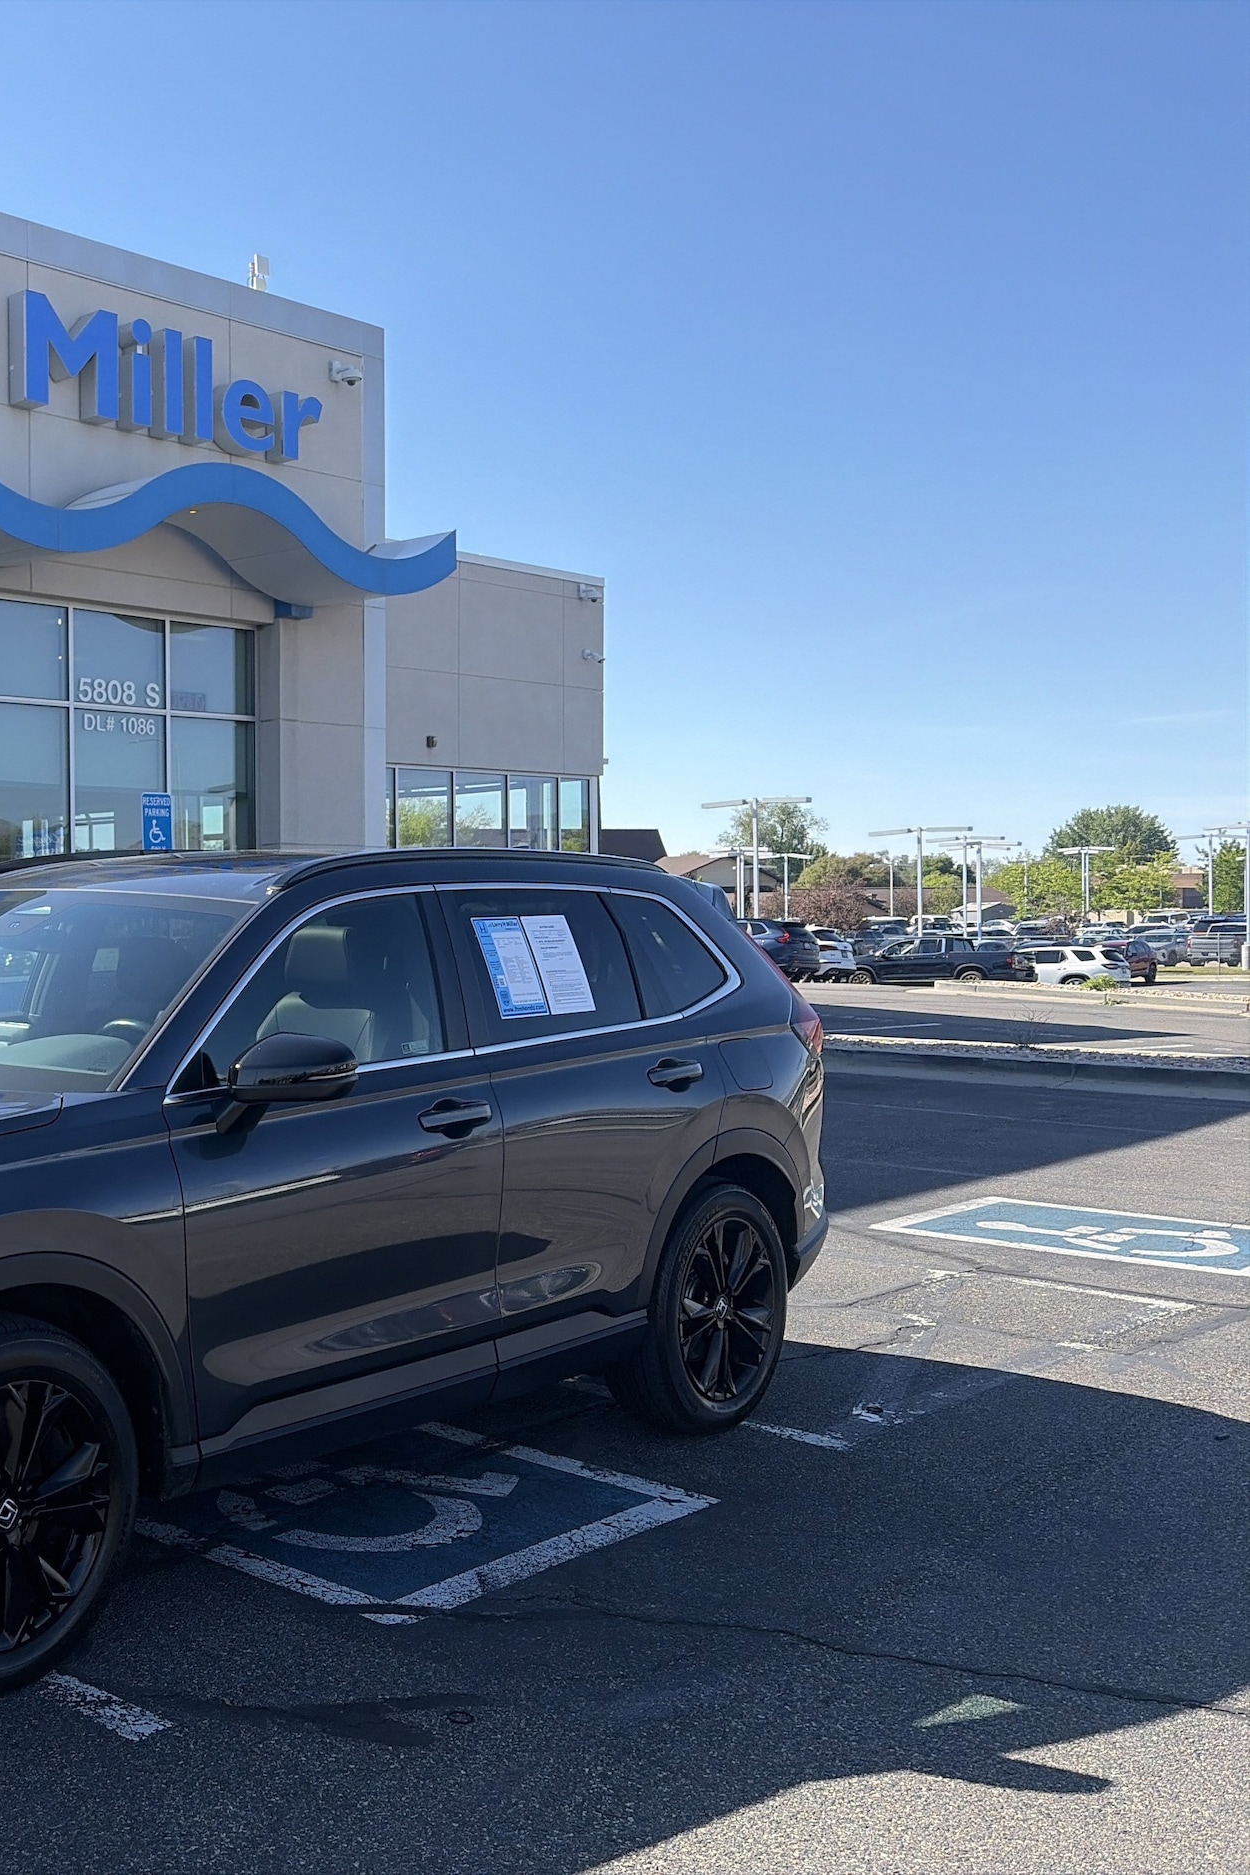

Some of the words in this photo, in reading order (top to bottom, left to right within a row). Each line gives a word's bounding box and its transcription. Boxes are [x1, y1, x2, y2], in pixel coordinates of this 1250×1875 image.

[9, 290, 322, 463] Miller
[78, 677, 136, 705] 5808
[145, 682, 160, 708] S
[83, 713, 115, 732] DL#
[120, 717, 155, 735] 1086
[143, 796, 170, 806] RESERVED
[144, 807, 170, 817] PARKING
